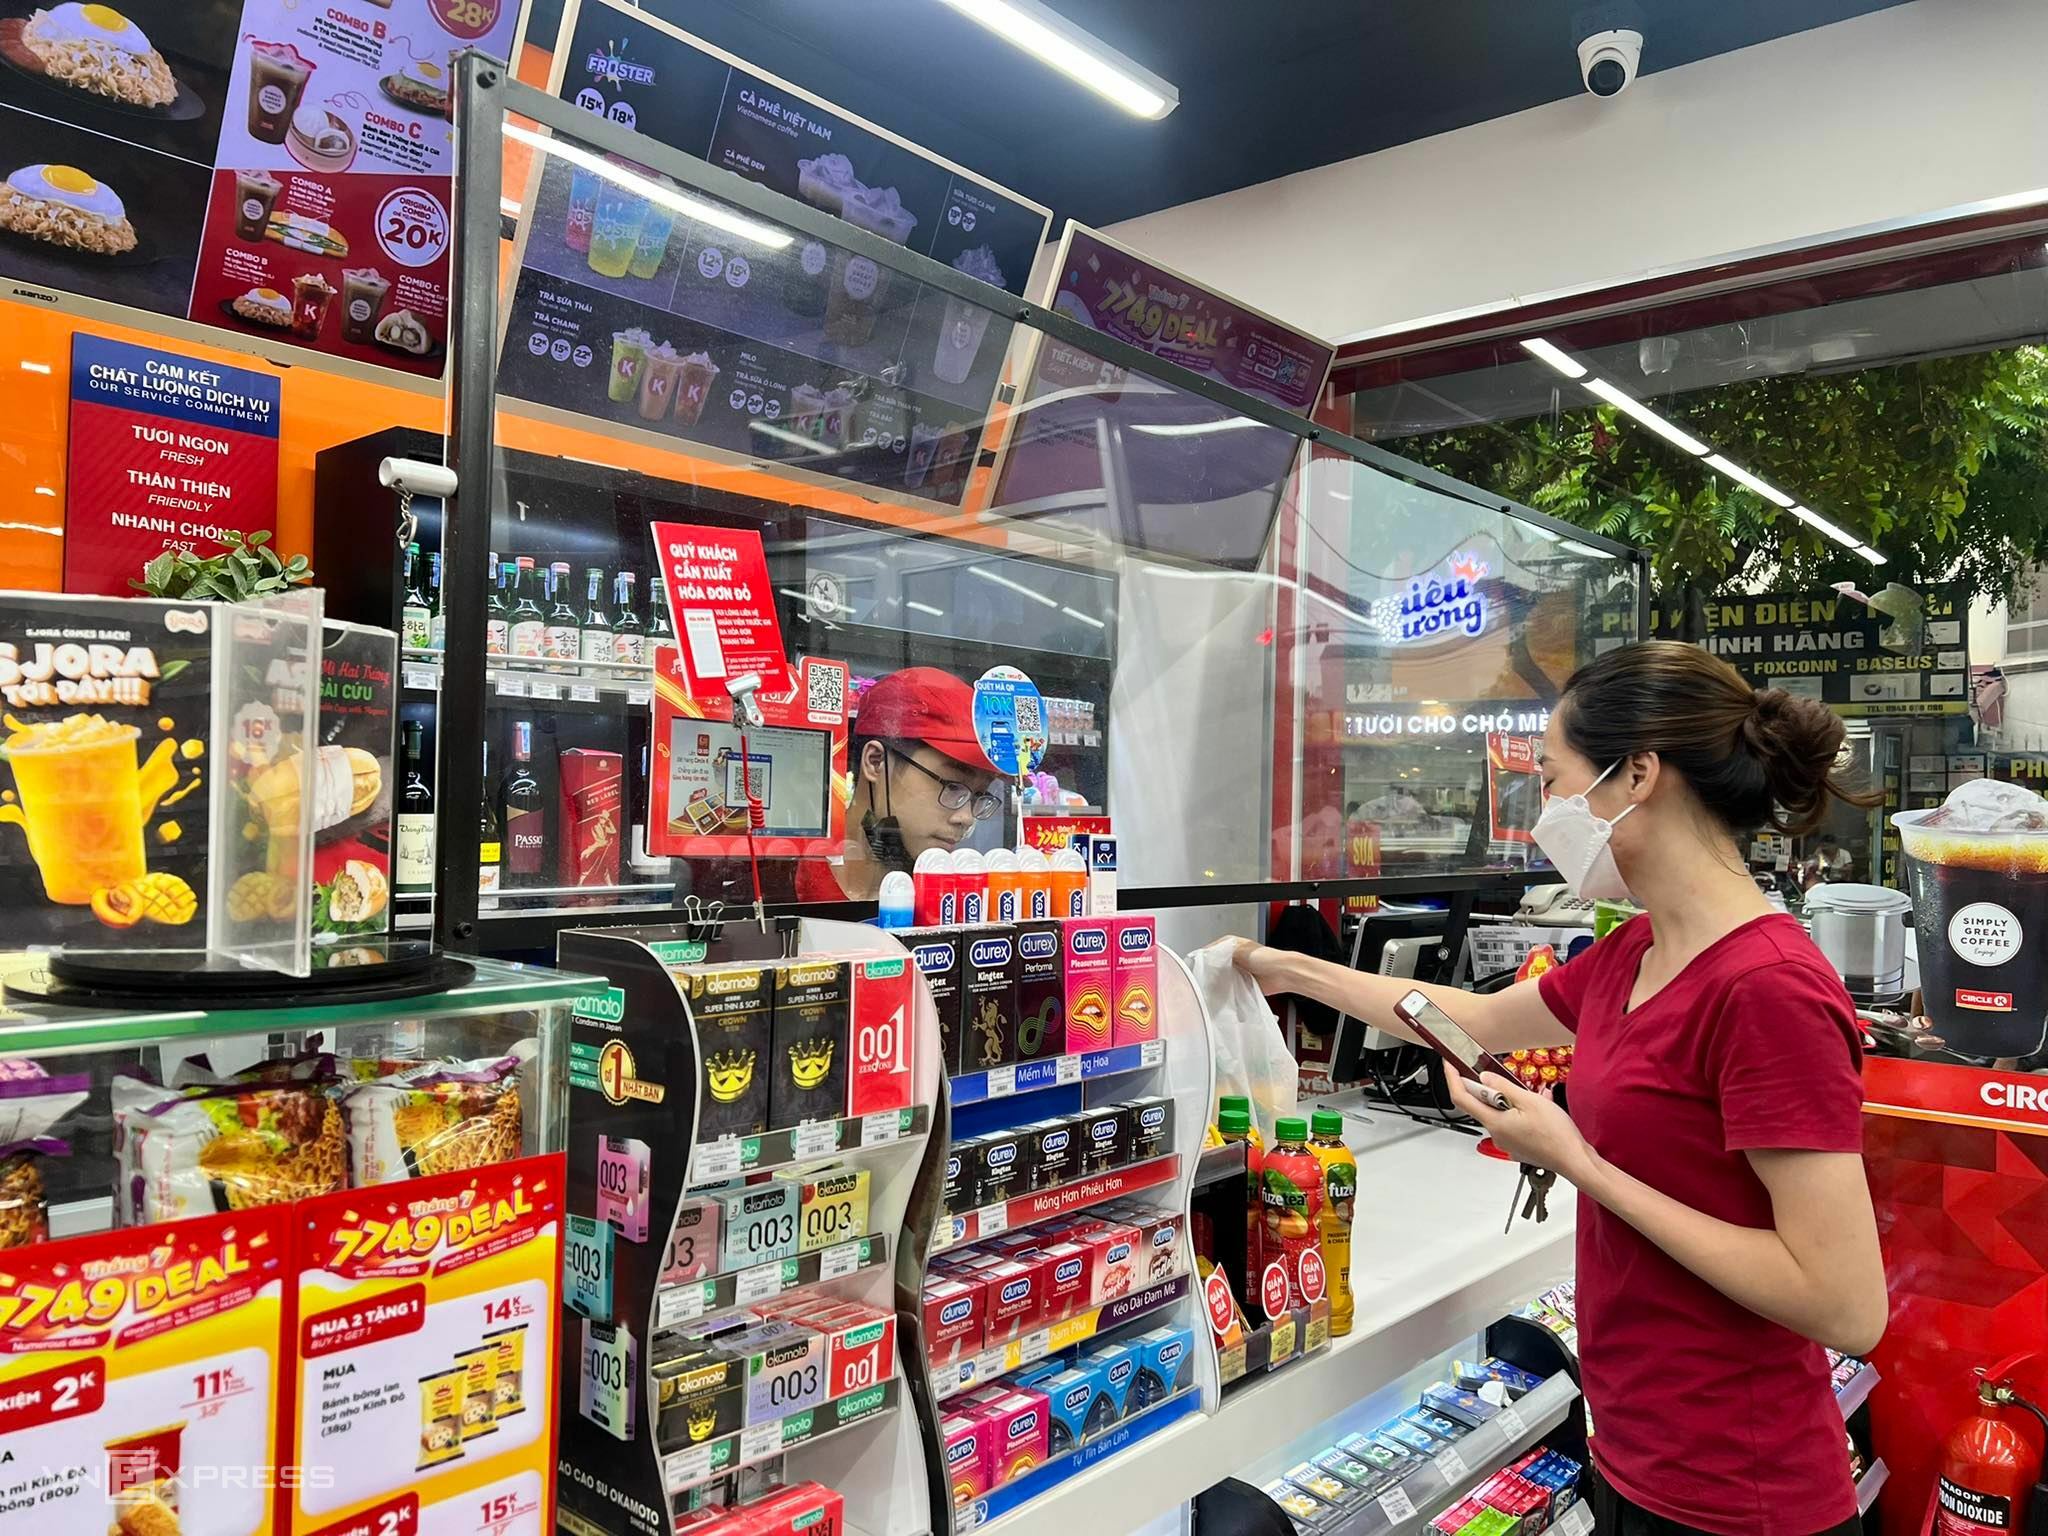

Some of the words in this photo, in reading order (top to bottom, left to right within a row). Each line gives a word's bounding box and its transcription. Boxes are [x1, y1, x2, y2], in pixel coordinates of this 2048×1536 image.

[327, 8, 369, 32] COMBO
[372, 21, 387, 39] B
[587, 53, 655, 85] FROSTER
[579, 93, 603, 111] 15K
[611, 106, 634, 124] 18K
[739, 89, 755, 105] CÀ
[757, 97, 780, 118] PHÊ
[781, 110, 807, 129] VIỆT
[806, 121, 832, 141] NAM
[365, 112, 405, 133] COMBO
[408, 122, 422, 139] C
[736, 104, 775, 130] Vietnamese
[776, 120, 799, 139] coffee
[291, 176, 324, 191] COMBO
[399, 197, 438, 215] ORIGINAL
[384, 218, 442, 249] 20K
[226, 248, 260, 263] COMBO
[399, 275, 431, 290] COMBO
[538, 289, 556, 302] TRÀ
[534, 311, 551, 324] TRÀ
[551, 317, 580, 332] CHANH
[1098, 277, 1163, 339] 7749
[1163, 308, 1219, 348] DEAL
[531, 336, 547, 348] 12K
[553, 342, 569, 353] 15K
[575, 349, 592, 361] 22K
[145, 360, 184, 380] CAM
[187, 367, 220, 386] KẾT
[622, 361, 634, 376] K
[89, 362, 139, 386] CHẤT
[142, 376, 202, 401] LƯỢNG
[205, 390, 244, 409] DỊCH
[248, 398, 270, 415] VỤ
[652, 378, 665, 394] K
[688, 384, 701, 401] K
[89, 379, 119, 393] OUR
[124, 386, 180, 406] SERVICE
[185, 398, 270, 424] COMMITMENT
[131, 425, 174, 445] TƯƠI
[178, 436, 229, 455] NGON
[159, 449, 205, 466] FRESH
[180, 477, 231, 499] THIỆN
[147, 494, 213, 514] FRIENDLY
[111, 512, 176, 533] NHANH
[162, 538, 197, 552] FAST
[698, 543, 738, 561] KHÁCH
[703, 561, 733, 581] XUẤT
[678, 582, 706, 600] HÓA
[706, 585, 735, 601] ĐƠN
[734, 583, 752, 601] ĐỎ
[1754, 599, 1836, 629] ĐIỆN
[1773, 630, 1865, 651] HÃNG
[0, 642, 160, 683] SJORA
[1753, 659, 1838, 675] FOXCONN
[1856, 655, 1932, 671] BASEUS
[341, 681, 373, 701] CỨU
[977, 680, 996, 692] QUÉT
[1005, 683, 1015, 692] QR
[982, 696, 1014, 716] 10K
[1407, 714, 1457, 734] CHO
[1462, 708, 1514, 733] CHÓ
[1096, 853, 1113, 864] KY
[1963, 916, 2009, 928] SIMPLY
[1075, 933, 1104, 950] durex
[1122, 928, 1149, 945] durex
[1960, 936, 2011, 948] COFFEE
[1964, 927, 2007, 938] GREAT
[974, 944, 1008, 963] durex
[1022, 936, 1054, 953] durex
[790, 968, 836, 986] okamoto
[977, 971, 1005, 982] Kingtex
[1024, 962, 1053, 973] Performa
[707, 974, 758, 994] okamoto
[704, 1003, 724, 1014] SUPER
[787, 995, 805, 1005] SUPER
[1960, 993, 1993, 1005] CIRCLE
[611, 1047, 622, 1098] 1
[1092, 1057, 1109, 1068] Hoa
[818, 1180, 856, 1197] okamoto
[1034, 1195, 1060, 1212] Mỏng
[1061, 1190, 1080, 1204] Hơn
[1105, 1178, 1123, 1192] Hơn
[1328, 1182, 1355, 1198] fuze
[409, 1196, 458, 1217] Tháng
[459, 1190, 476, 1209] 7
[745, 1192, 785, 1213] okamoto
[329, 1216, 442, 1269] 7749
[446, 1187, 533, 1249] DEAL
[82, 1255, 148, 1280] Tháng
[150, 1246, 174, 1268] 7
[355, 1266, 398, 1278] Numerous
[1056, 1261, 1081, 1280] durex
[1302, 1259, 1321, 1275] GIẢM
[135, 1242, 249, 1314] DEAL
[576, 1275, 601, 1299] COOL
[1266, 1274, 1284, 1292] GIẢM
[1306, 1272, 1319, 1285] GIÁ
[1003, 1281, 1029, 1300] durex
[1209, 1284, 1227, 1304] GIẢM
[1269, 1286, 1282, 1300] GIÁ
[482, 1296, 522, 1326] 14K
[943, 1301, 972, 1321] durex
[1113, 1299, 1129, 1317] Kéo
[1129, 1294, 1143, 1310] Dài
[1144, 1290, 1163, 1305] Đam
[1214, 1298, 1227, 1314] GIÁ
[311, 1319, 350, 1338] MUA
[351, 1312, 363, 1328] 2
[365, 1303, 409, 1324] TẶNG
[412, 1300, 419, 1314] 1
[12, 1336, 67, 1352] Numerous
[310, 1336, 333, 1350] BUY
[343, 1329, 364, 1341] GET
[766, 1344, 808, 1367] okamoto
[323, 1363, 356, 1381] MUA
[679, 1369, 726, 1392] okamoto
[0, 1389, 42, 1410] KIỆM
[51, 1371, 97, 1412] 2K
[192, 1367, 235, 1401] 11K
[322, 1394, 350, 1411] Bánh
[353, 1386, 381, 1405] bông
[384, 1381, 400, 1395] lan
[339, 1403, 361, 1418] nho
[362, 1397, 388, 1413] Kinh
[321, 1421, 353, 1439] (38g)
[1009, 1414, 1036, 1436] durex
[1085, 1449, 1097, 1461] Tin
[1340, 1460, 1369, 1484] XS
[9, 1482, 28, 1496] mì
[39, 1484, 81, 1503] (80g)
[573, 1469, 595, 1490] CAO
[596, 1479, 608, 1497] SU
[609, 1484, 660, 1526] OKAMOTO
[1310, 1477, 1343, 1499] XS
[480, 1494, 518, 1525] 15K
[1285, 1494, 1317, 1517] XS
[1956, 1500, 2003, 1525] DIOXIDE
[377, 1504, 411, 1536] 2K
